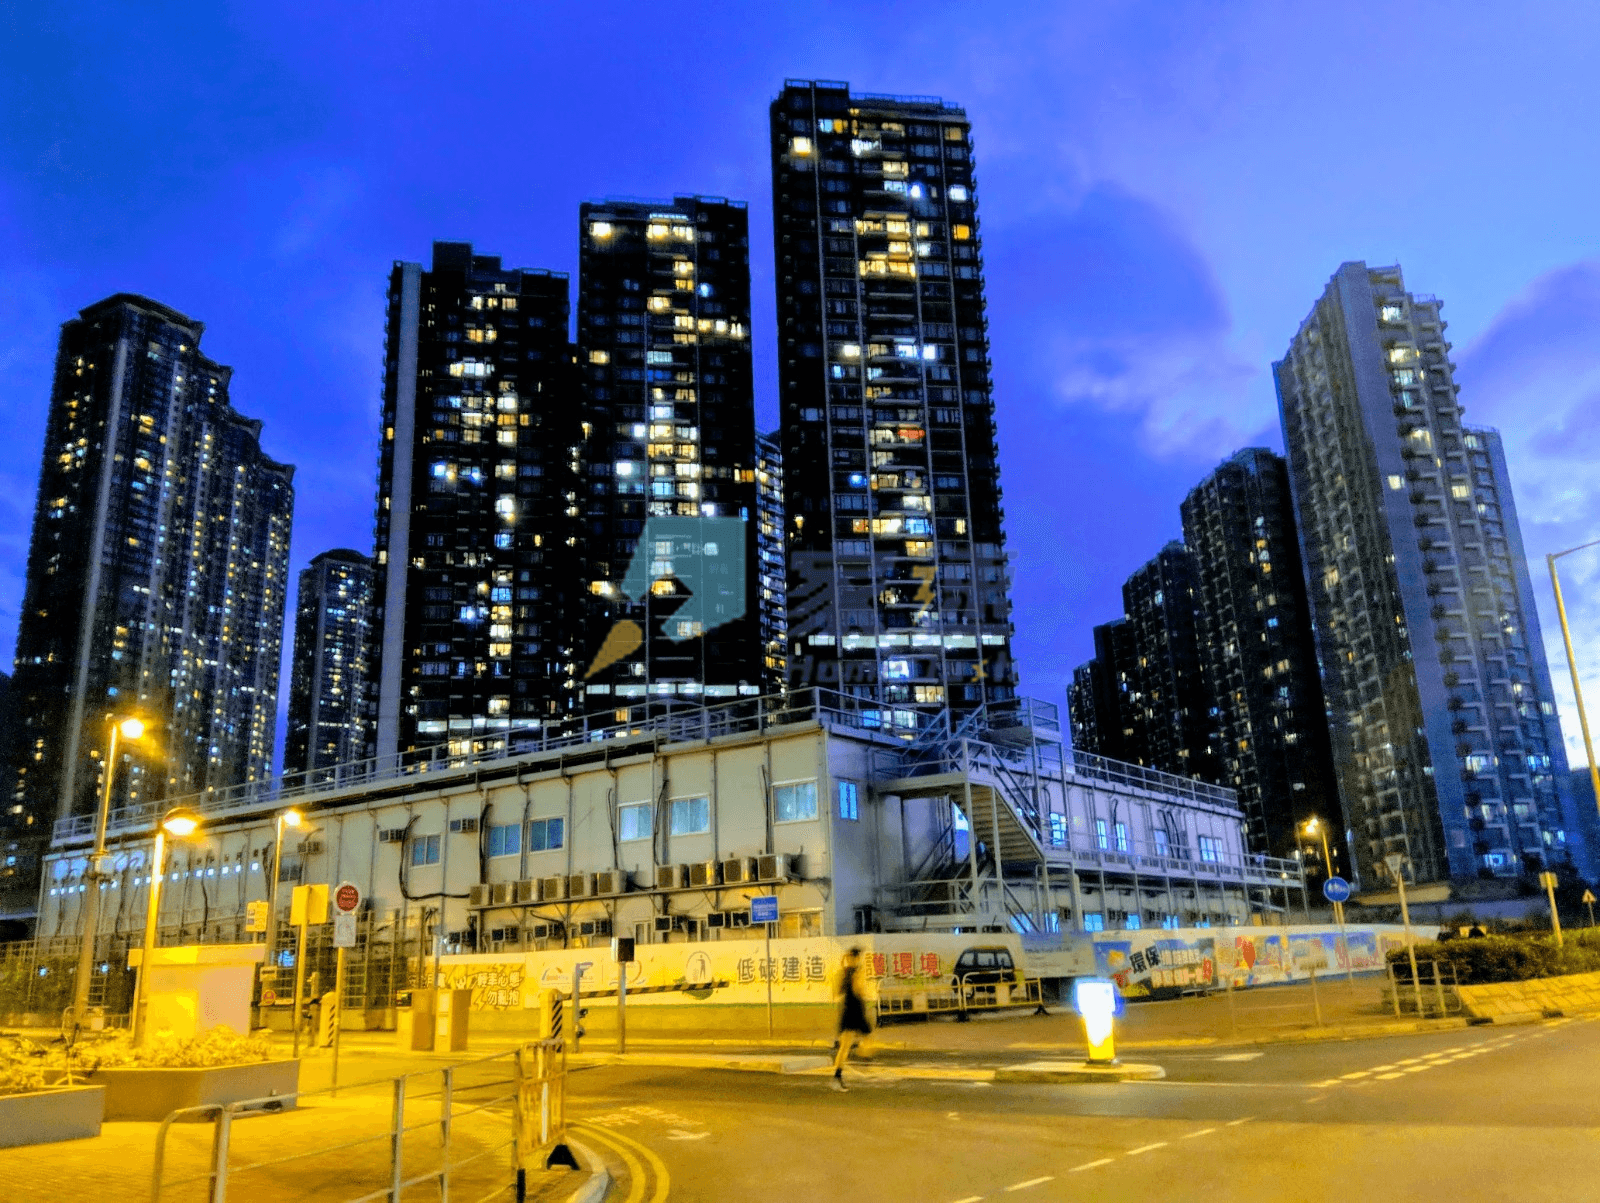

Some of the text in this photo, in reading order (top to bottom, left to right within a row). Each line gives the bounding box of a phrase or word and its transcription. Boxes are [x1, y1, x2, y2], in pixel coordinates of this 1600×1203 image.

[736, 955, 825, 984] 低碳建造
[1129, 945, 1161, 974] 環保
